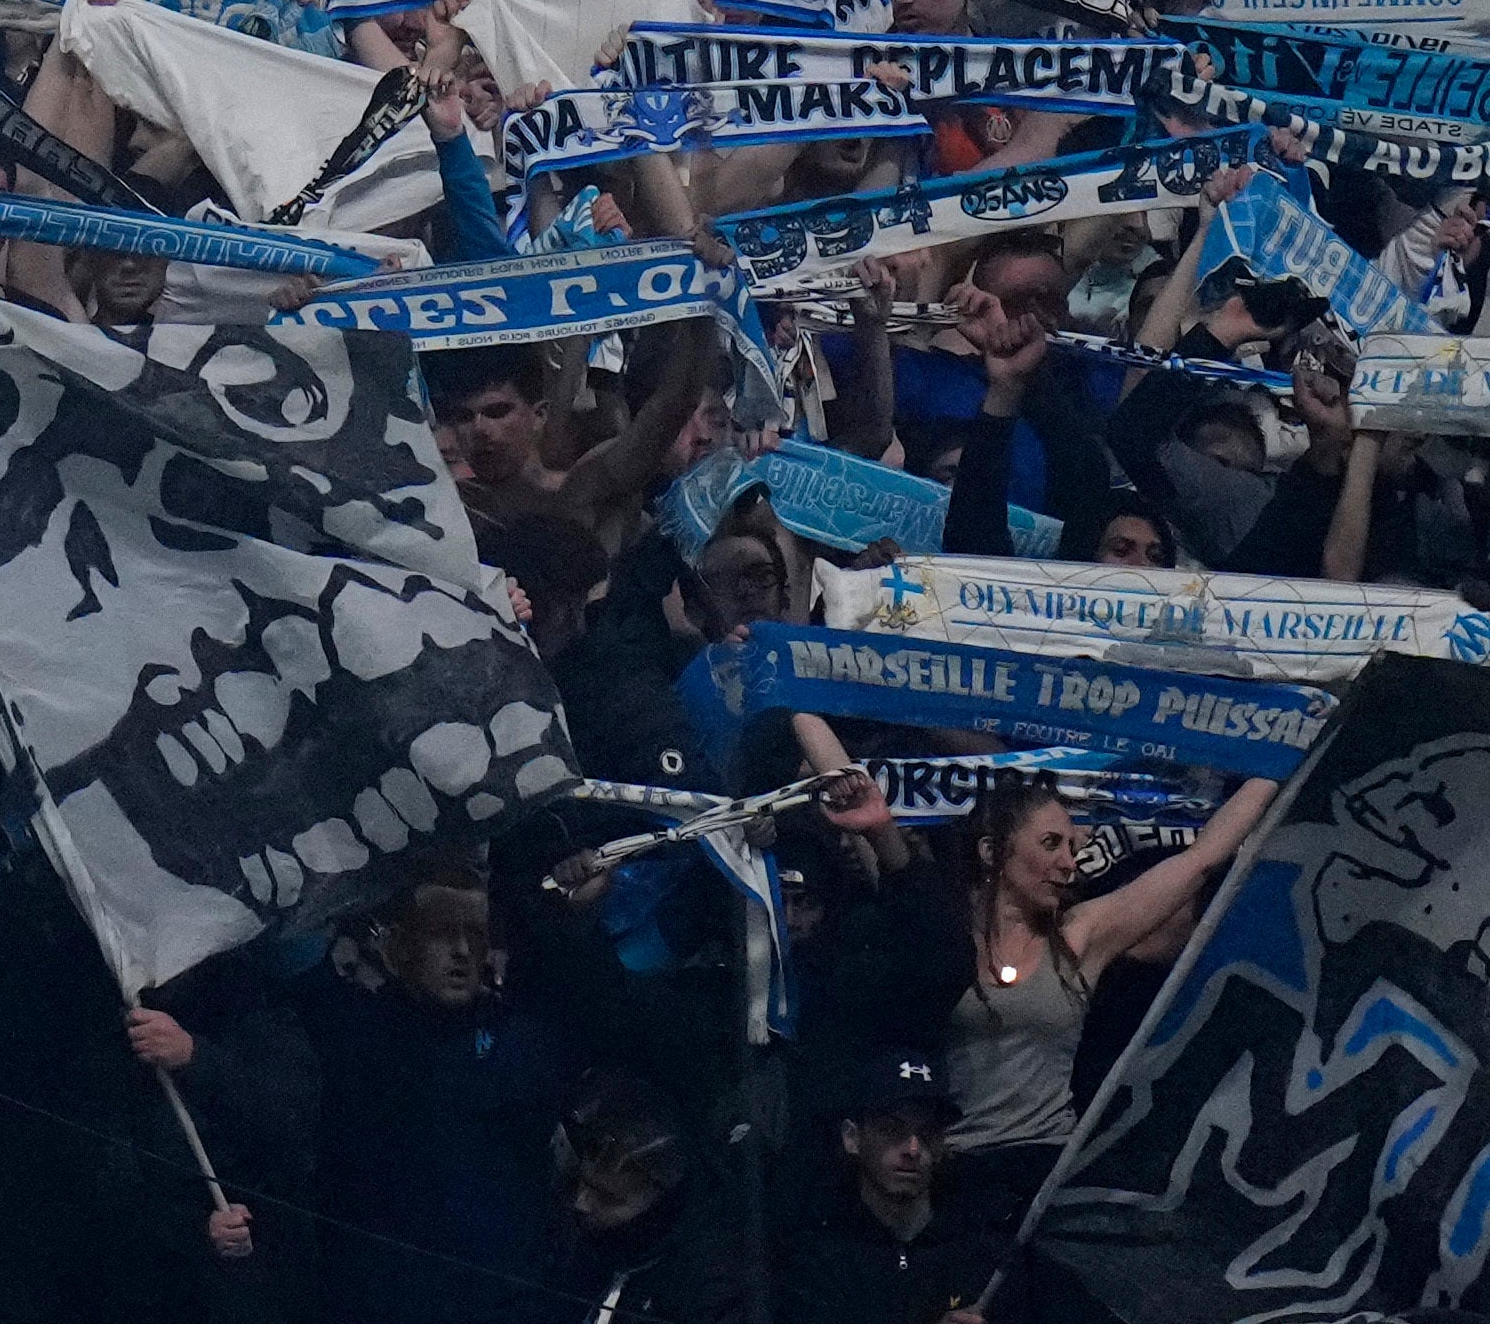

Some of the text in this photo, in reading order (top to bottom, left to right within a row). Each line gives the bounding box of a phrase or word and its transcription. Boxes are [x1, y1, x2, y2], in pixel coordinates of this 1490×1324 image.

[959, 582, 1412, 644] OLYMPIQUE DE MARSEILLE
[1036, 665, 1140, 718] TROP
[1013, 720, 1092, 747] FOUTRE
